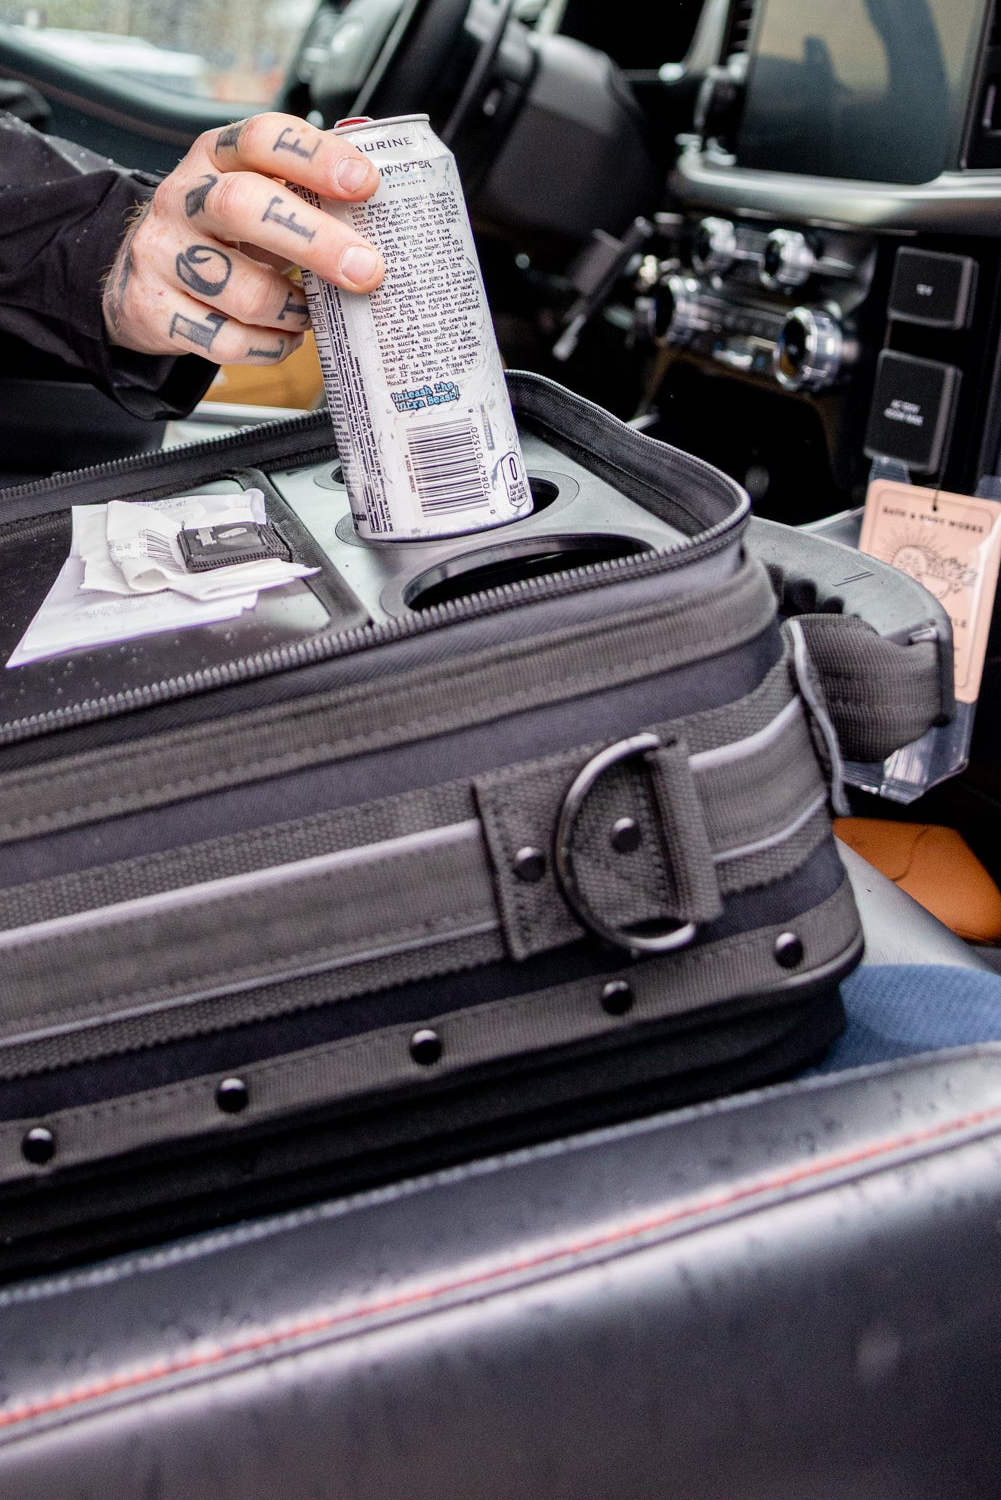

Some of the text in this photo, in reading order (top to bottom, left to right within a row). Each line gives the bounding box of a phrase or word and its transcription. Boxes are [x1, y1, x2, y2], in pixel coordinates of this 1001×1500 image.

[391, 380, 456, 401] Unleash the
[396, 388, 461, 411] Ultra Beast!
[471, 426, 484, 459] 01520
[478, 464, 491, 495] 70847
